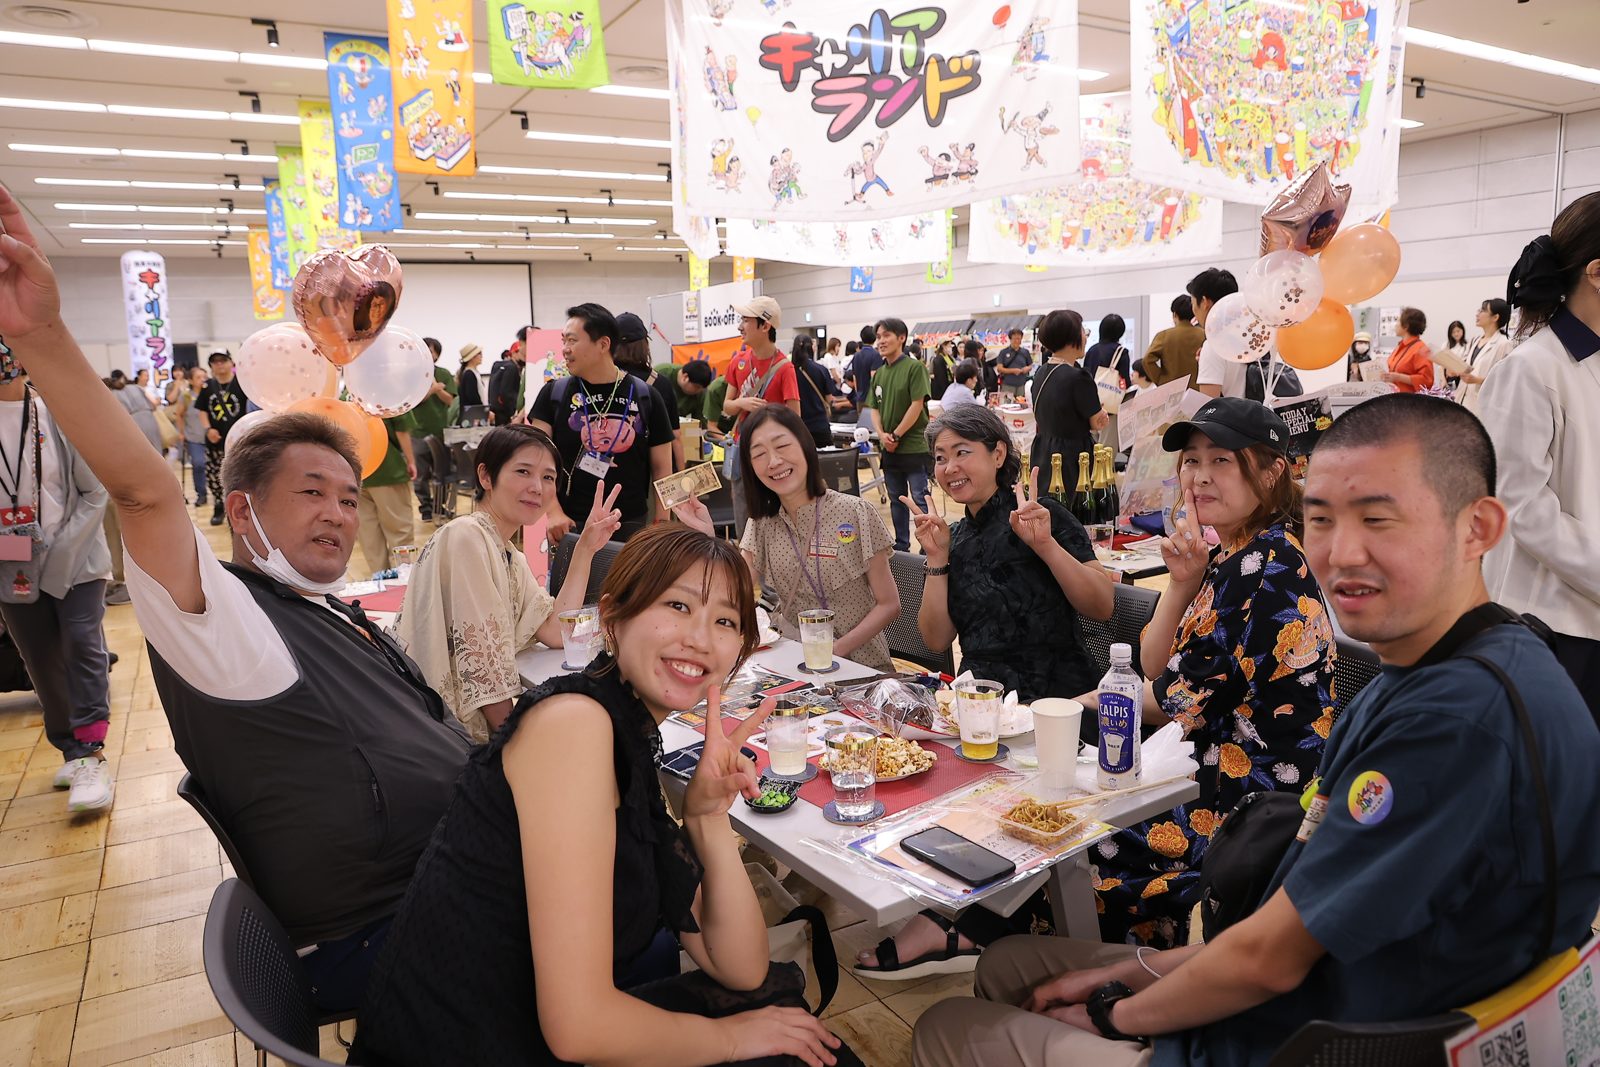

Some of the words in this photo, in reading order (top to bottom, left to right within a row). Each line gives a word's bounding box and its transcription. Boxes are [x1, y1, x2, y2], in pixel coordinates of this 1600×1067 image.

[759, 7, 947, 93] キャリア
[811, 50, 982, 142] ランド
[1280, 407, 1308, 421] TODAY
[1099, 703, 1129, 718] CALPIS
[1101, 716, 1128, 729] 濃いめ
